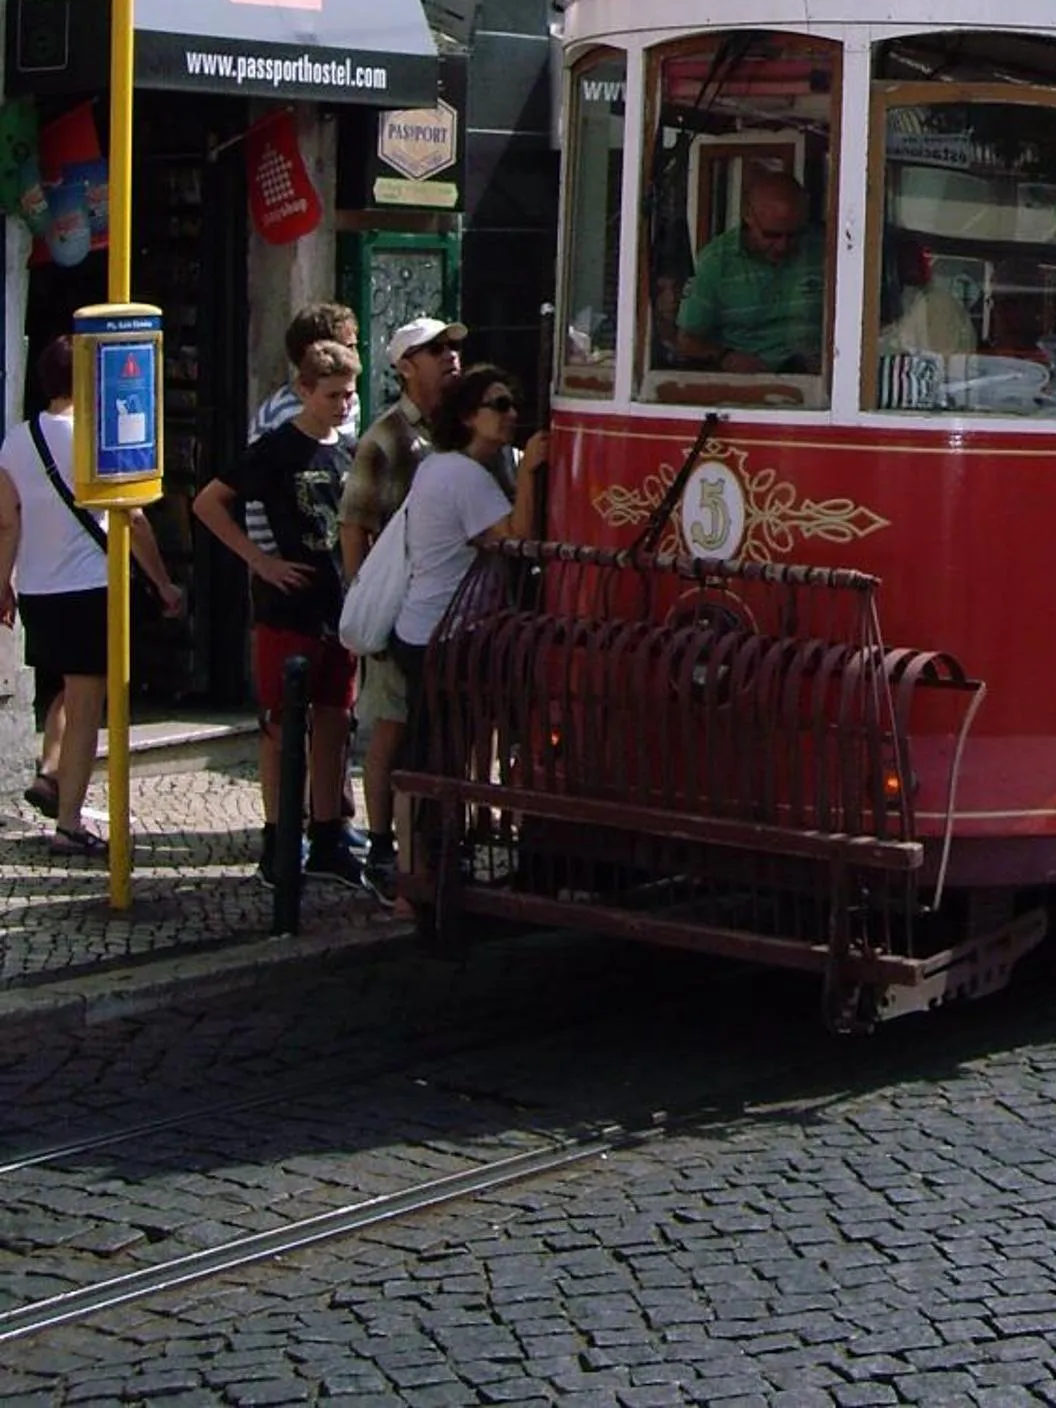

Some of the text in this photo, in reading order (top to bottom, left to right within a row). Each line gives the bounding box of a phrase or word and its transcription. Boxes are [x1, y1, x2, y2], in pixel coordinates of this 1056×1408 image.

[186, 51, 387, 90] www.passporthostel.com
[388, 123, 448, 143] PASSPORT
[690, 478, 732, 550] 5
